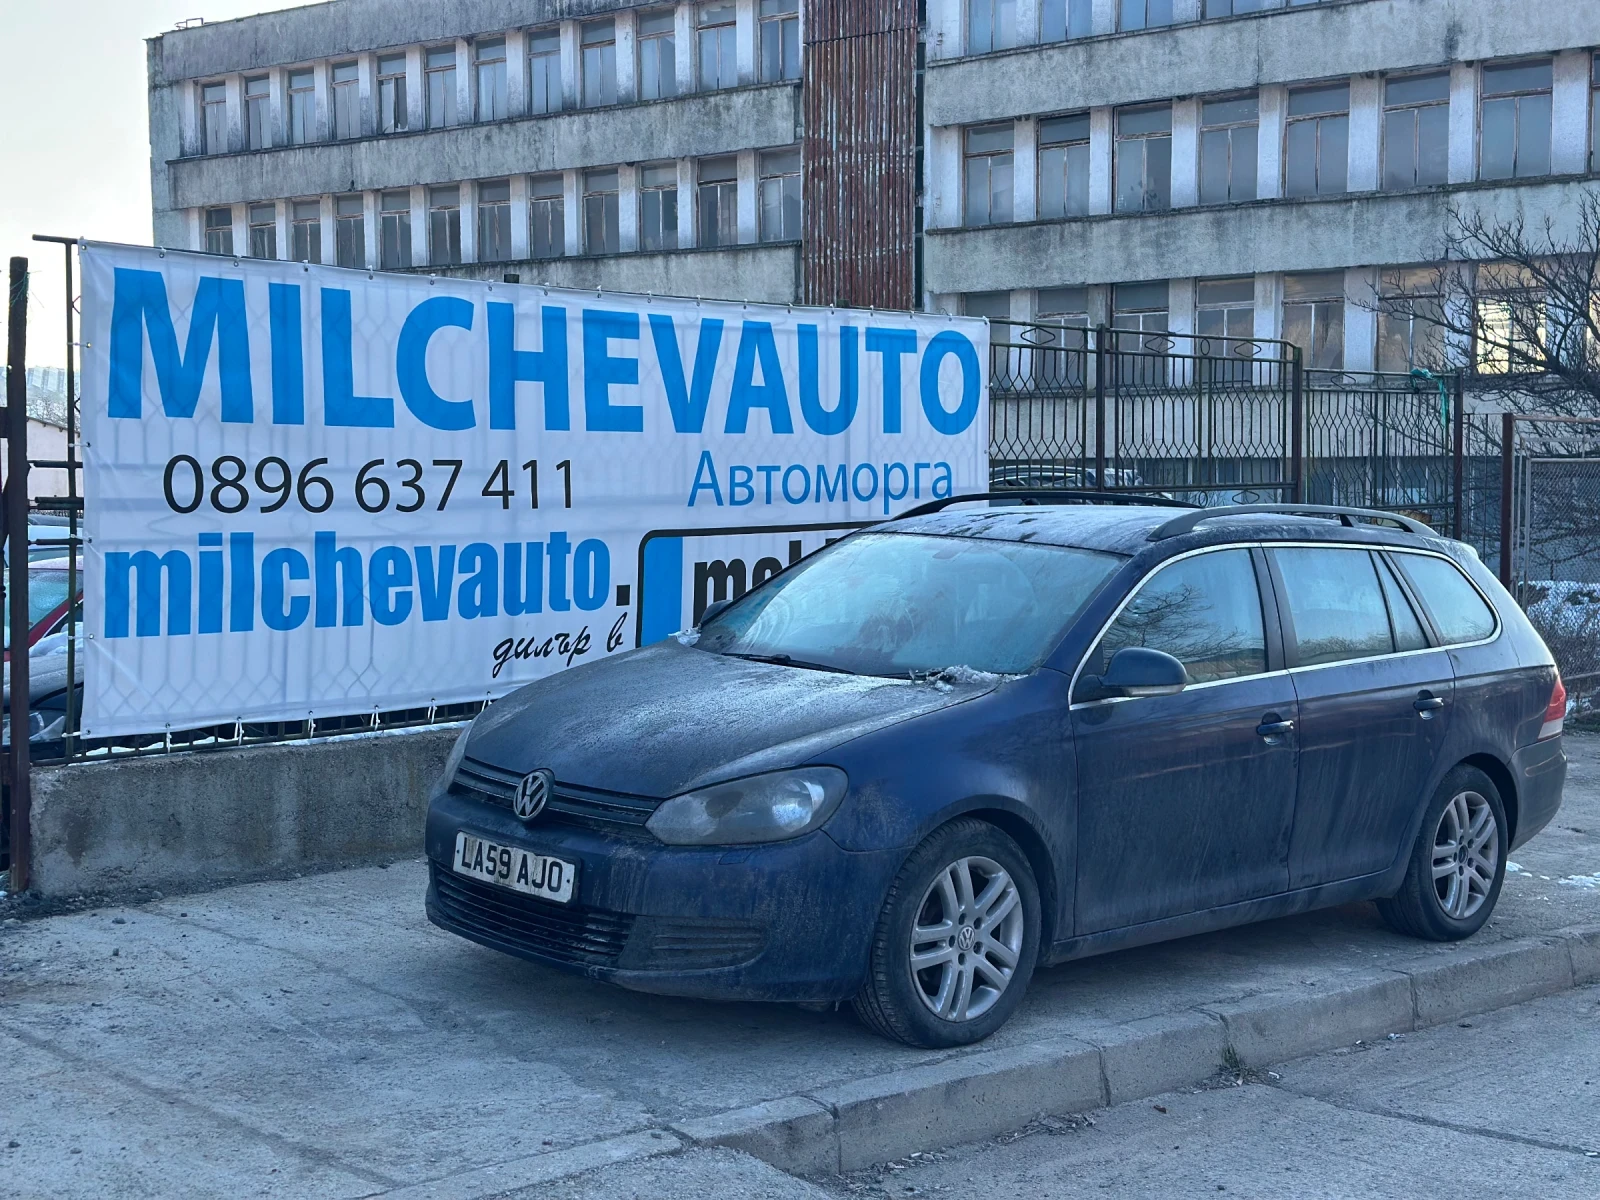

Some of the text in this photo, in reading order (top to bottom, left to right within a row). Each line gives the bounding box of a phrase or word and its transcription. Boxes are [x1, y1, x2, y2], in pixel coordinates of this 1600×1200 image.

[107, 266, 981, 436] MILCHEVAUTO
[163, 454, 572, 514] 0896 637 411
[687, 449, 954, 515] Автоморга
[461, 837, 563, 893] LA59 AJO
